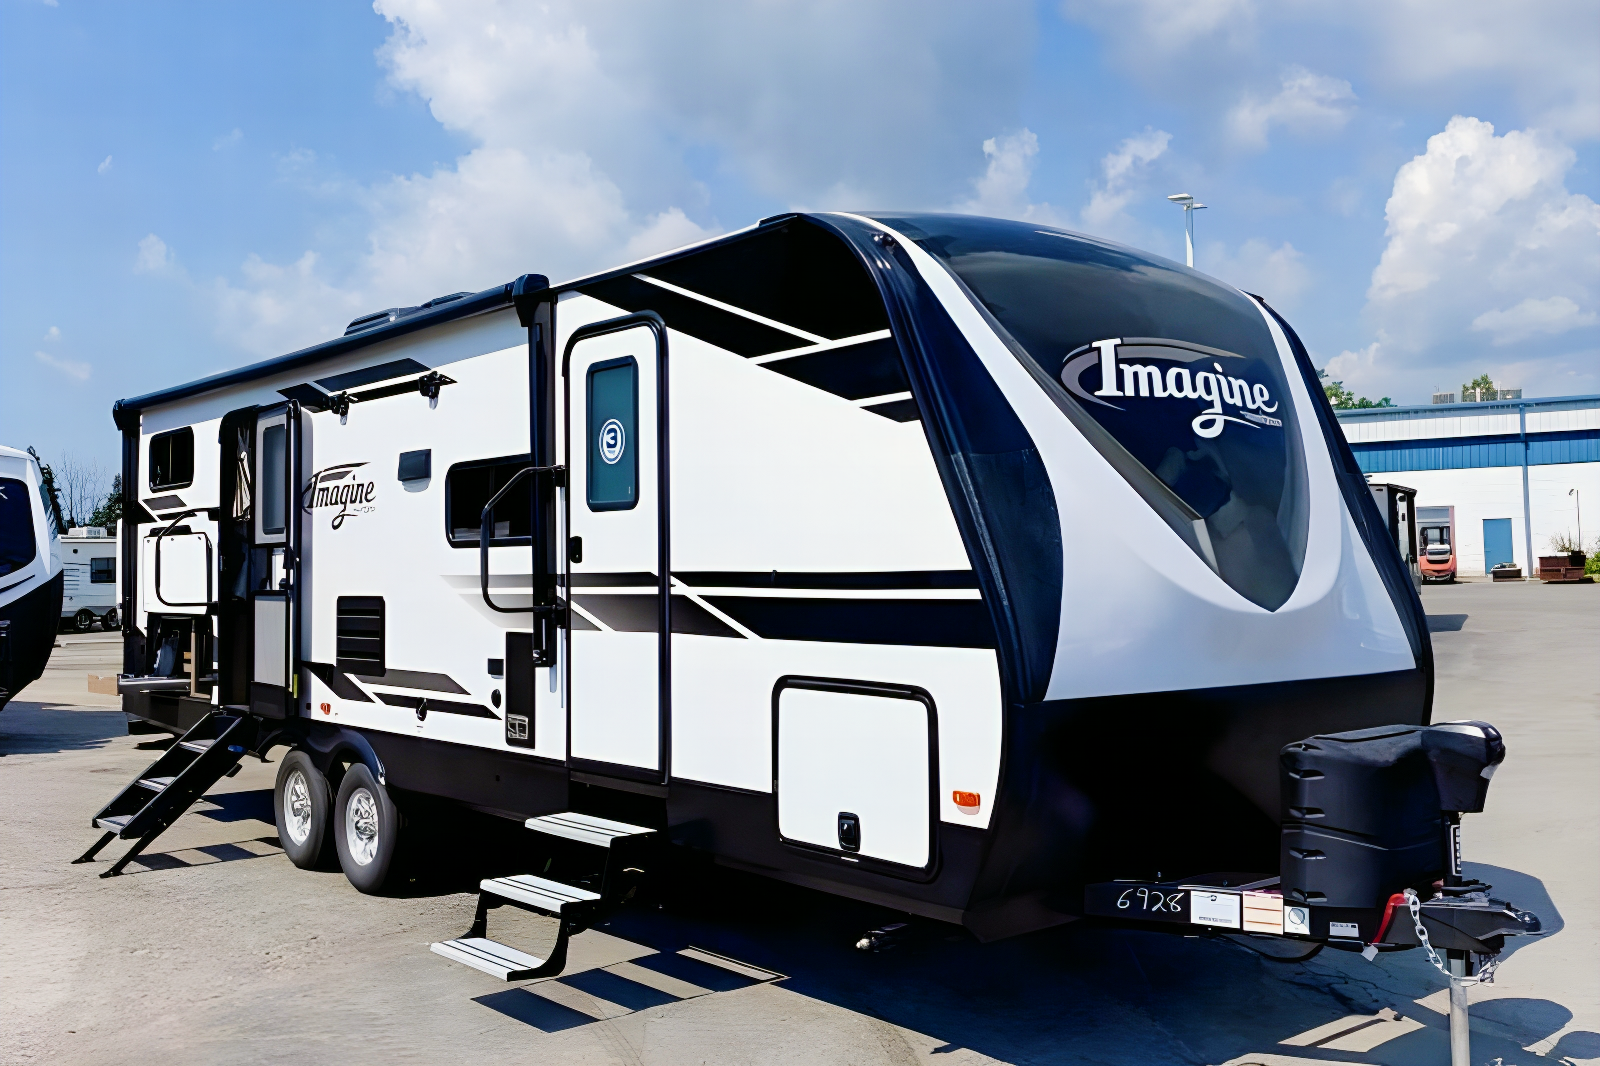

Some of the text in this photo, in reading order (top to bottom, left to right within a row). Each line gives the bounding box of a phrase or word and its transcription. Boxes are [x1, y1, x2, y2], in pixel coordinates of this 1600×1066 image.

[1091, 338, 1279, 438] Imagine
[304, 472, 377, 531] Imagine
[1116, 887, 1185, 913] 6928
